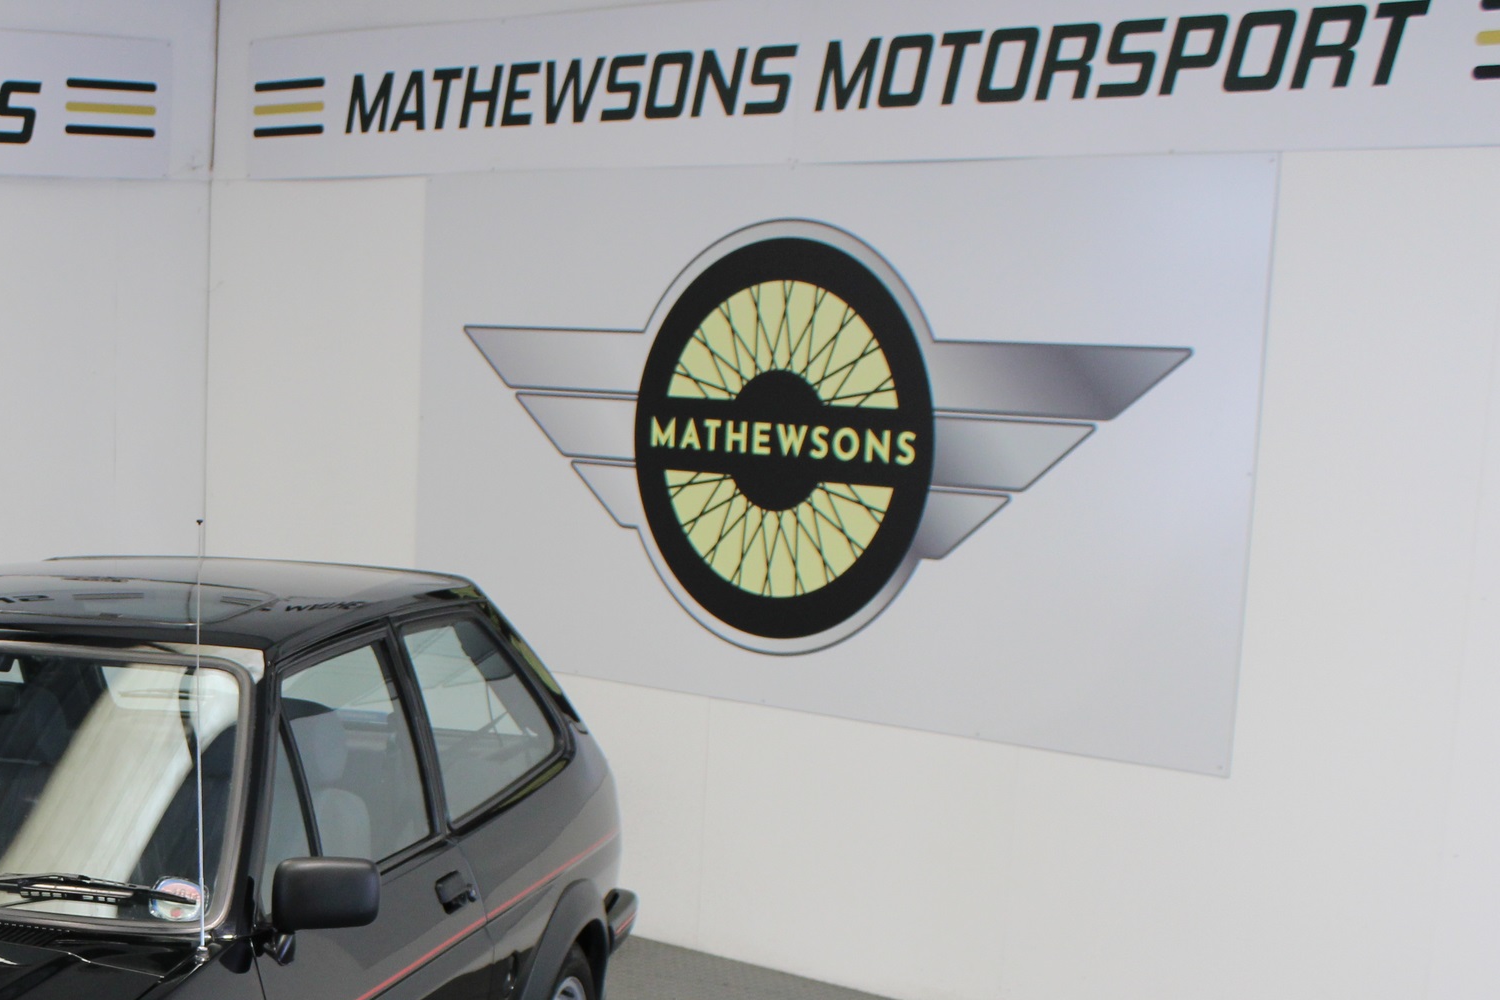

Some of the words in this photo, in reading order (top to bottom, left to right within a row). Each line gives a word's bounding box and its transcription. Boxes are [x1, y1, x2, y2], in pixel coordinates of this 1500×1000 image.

[344, 44, 798, 133] MATHEWSONS
[815, 1, 1431, 111] MOTORSPORT
[650, 416, 917, 465] MATHEWSONS
